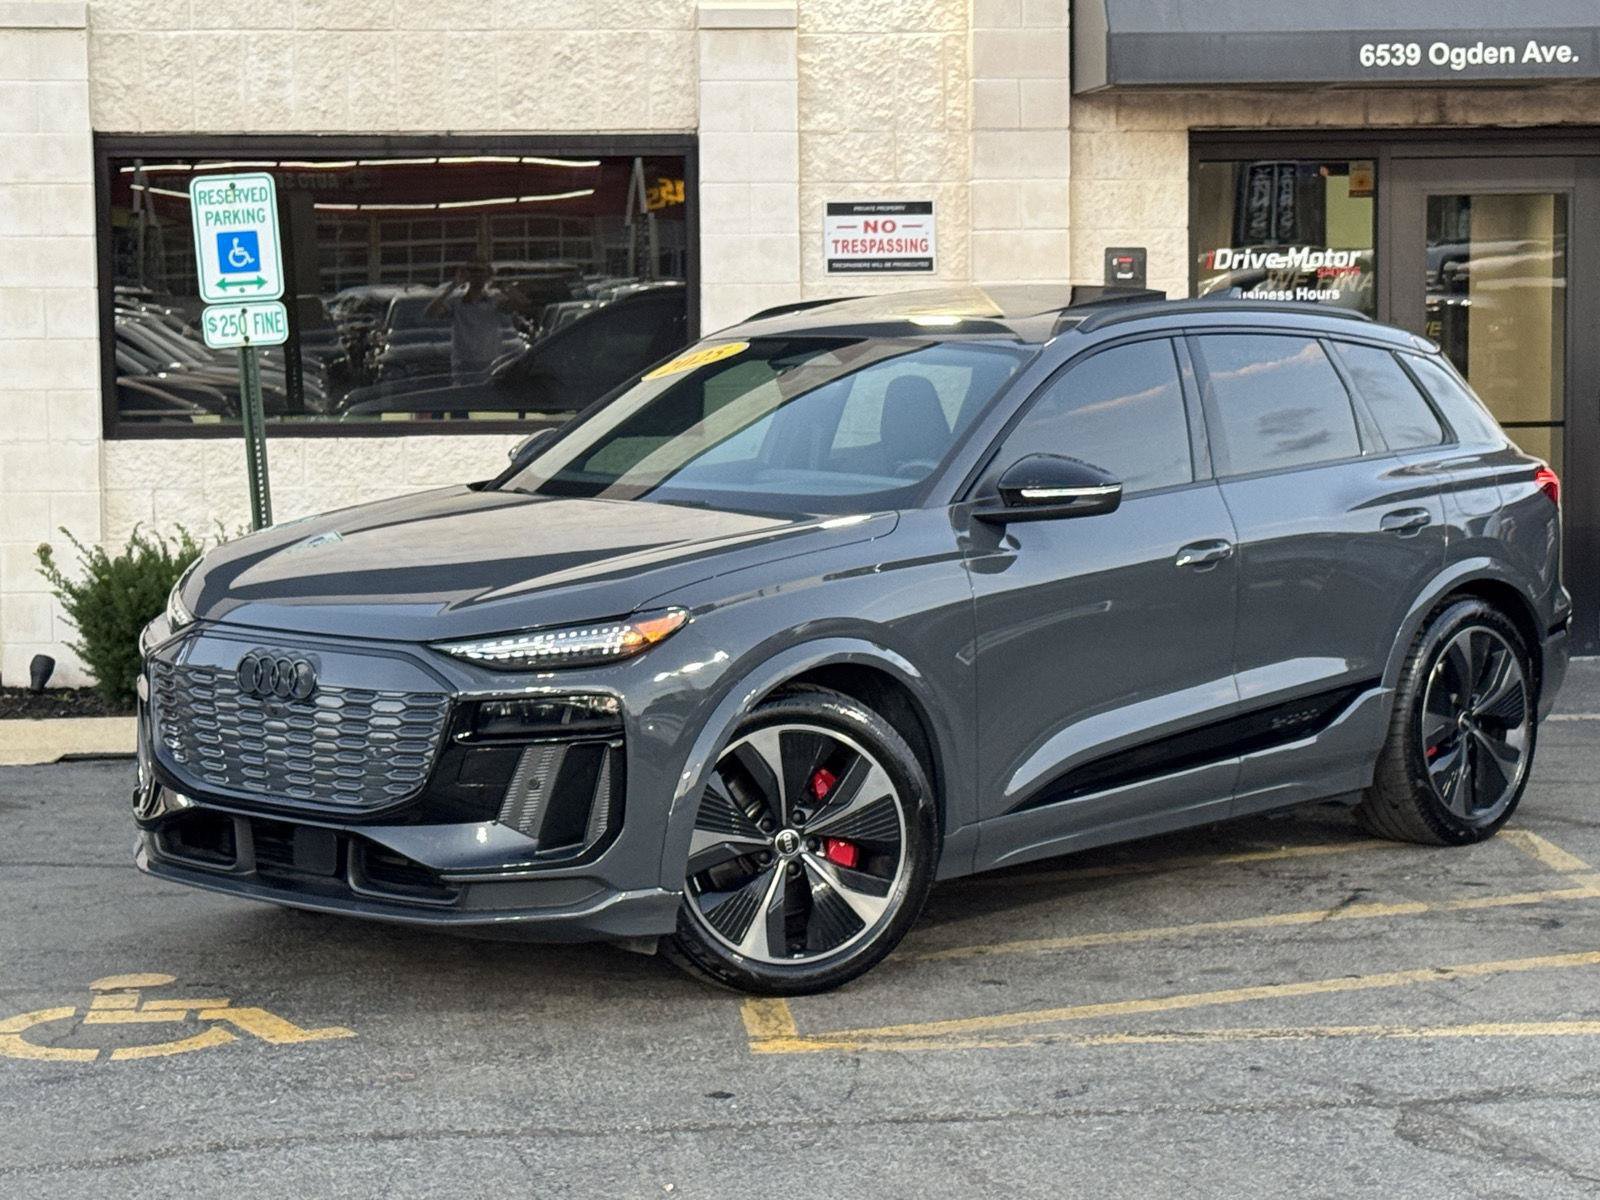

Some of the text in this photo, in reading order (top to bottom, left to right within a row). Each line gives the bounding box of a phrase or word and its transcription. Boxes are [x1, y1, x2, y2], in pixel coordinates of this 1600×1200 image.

[1359, 40, 1580, 71] 6539 Ogden Ave.
[198, 186, 269, 205] RESERVED
[205, 207, 266, 227] PARKING
[863, 219, 897, 234] NO
[832, 238, 929, 254] TRESPASSING
[1296, 286, 1341, 301] Hours
[207, 310, 284, 337] $250 FINE
